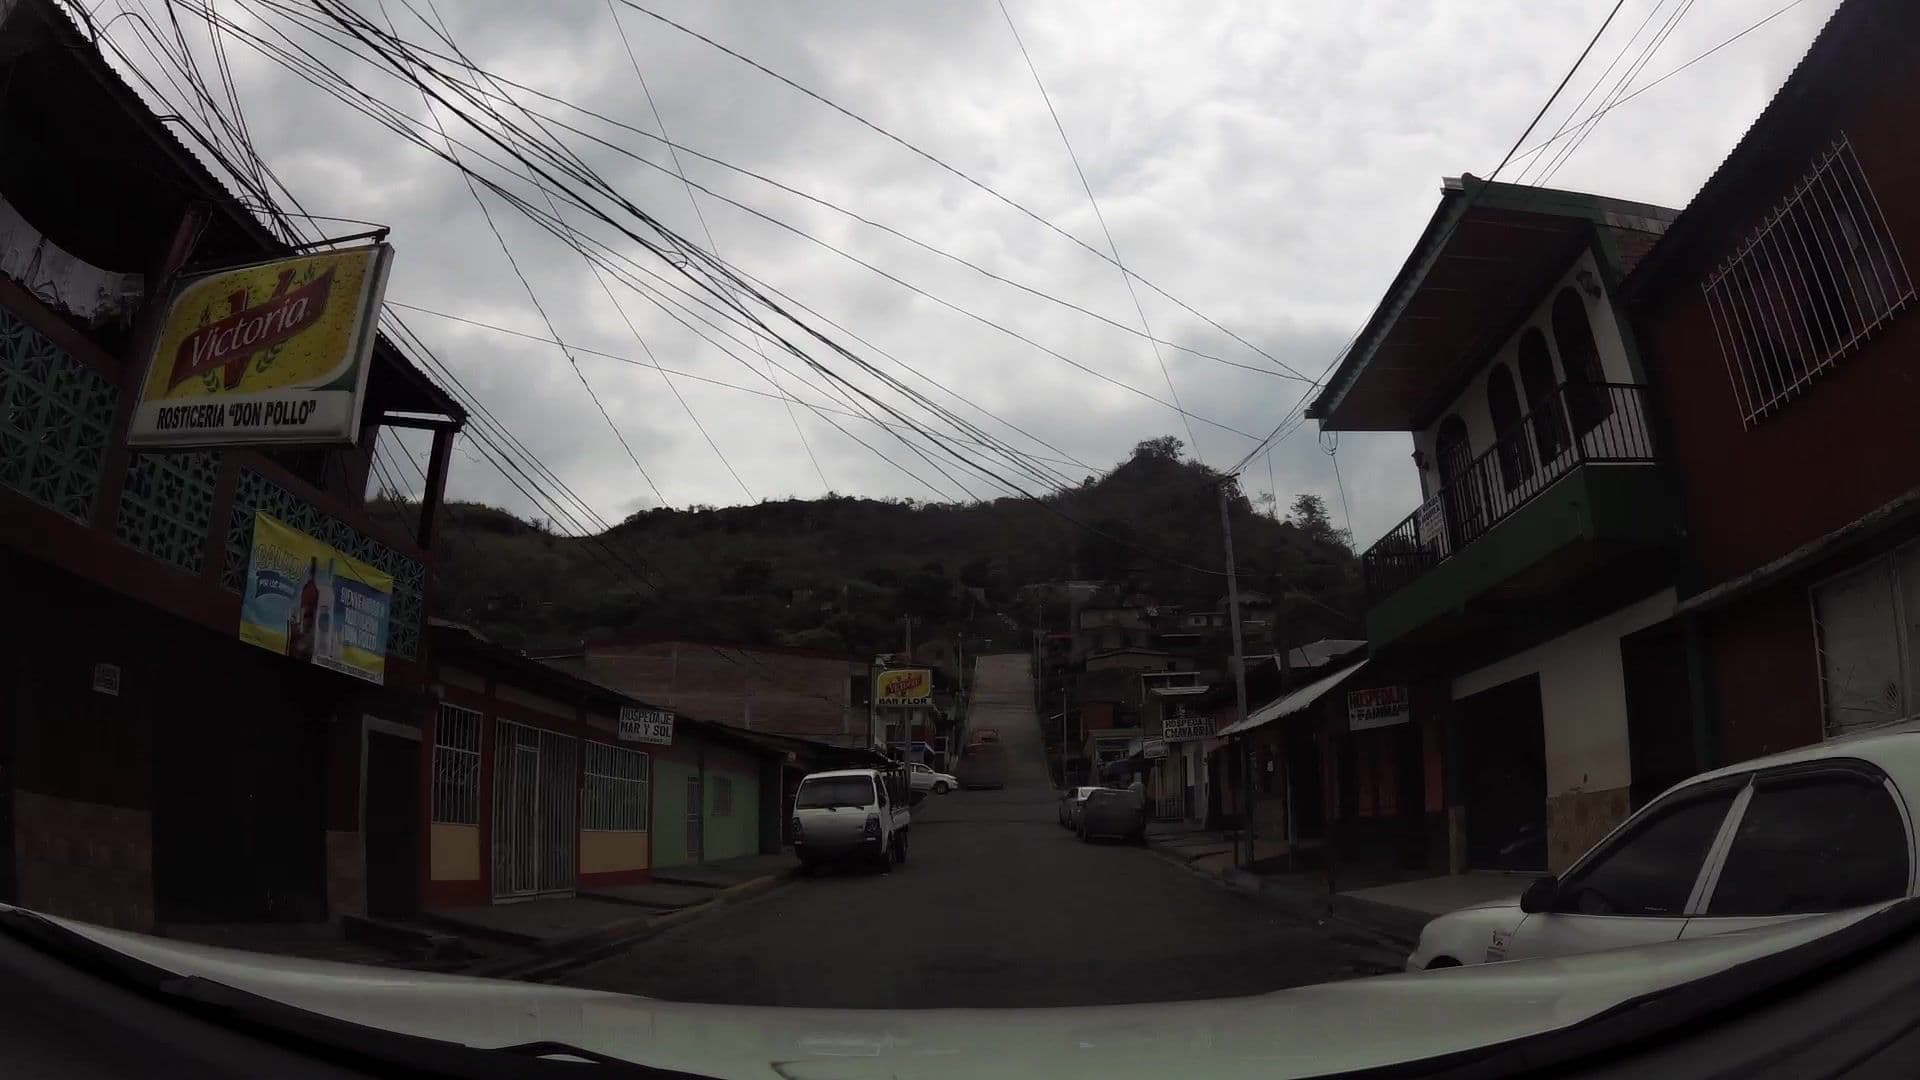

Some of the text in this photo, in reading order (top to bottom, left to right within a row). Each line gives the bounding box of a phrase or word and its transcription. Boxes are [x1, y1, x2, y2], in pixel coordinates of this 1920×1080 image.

[191, 295, 311, 368] Victoria
[156, 403, 225, 430] ROSTICERIA
[620, 720, 671, 739] MAR Y SOL
